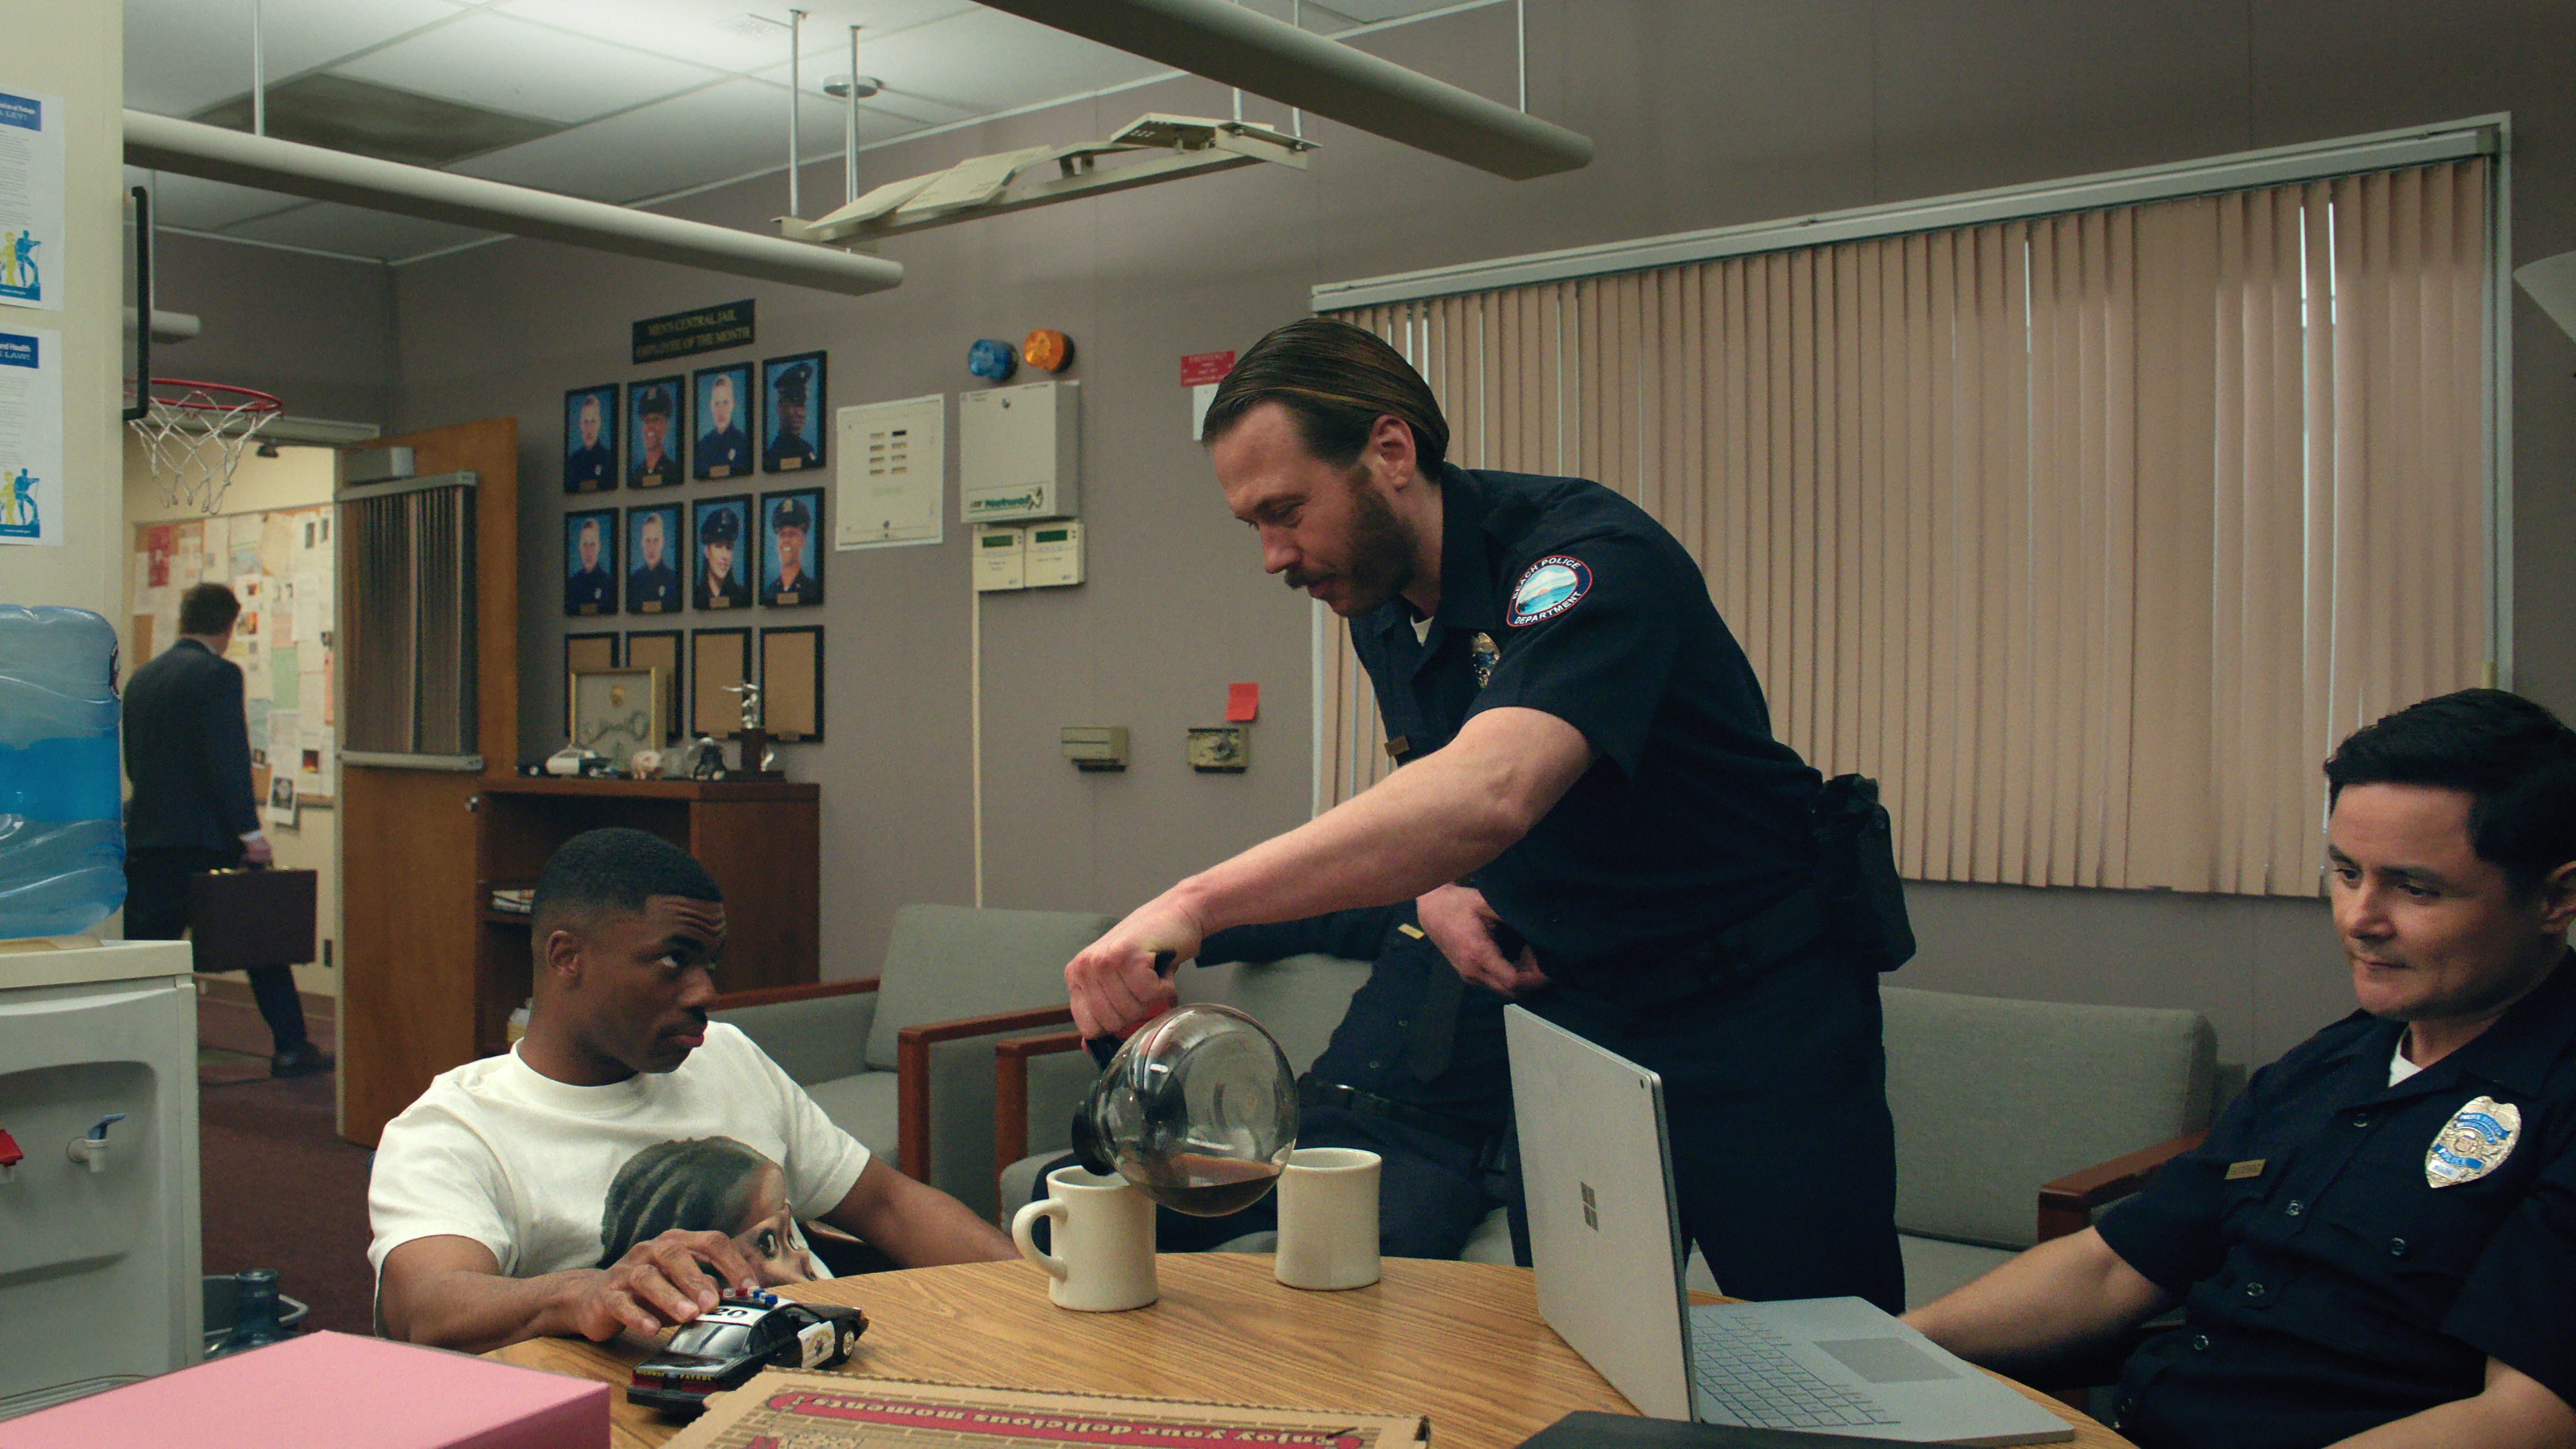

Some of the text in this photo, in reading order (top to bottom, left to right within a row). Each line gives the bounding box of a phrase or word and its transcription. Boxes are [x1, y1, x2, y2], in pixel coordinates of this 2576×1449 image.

[682, 336, 695, 349] OF
[696, 333, 714, 347] THE
[716, 326, 750, 342] MONTH
[1513, 558, 1581, 599] BEACH POLICE
[1514, 591, 1581, 624] DEPARTMENT
[635, 1369, 666, 1377] HIGHWAY
[973, 1414, 1133, 1435] delicious
[1139, 1427, 1227, 1439] your
[1232, 1431, 1336, 1446] Enjoy
